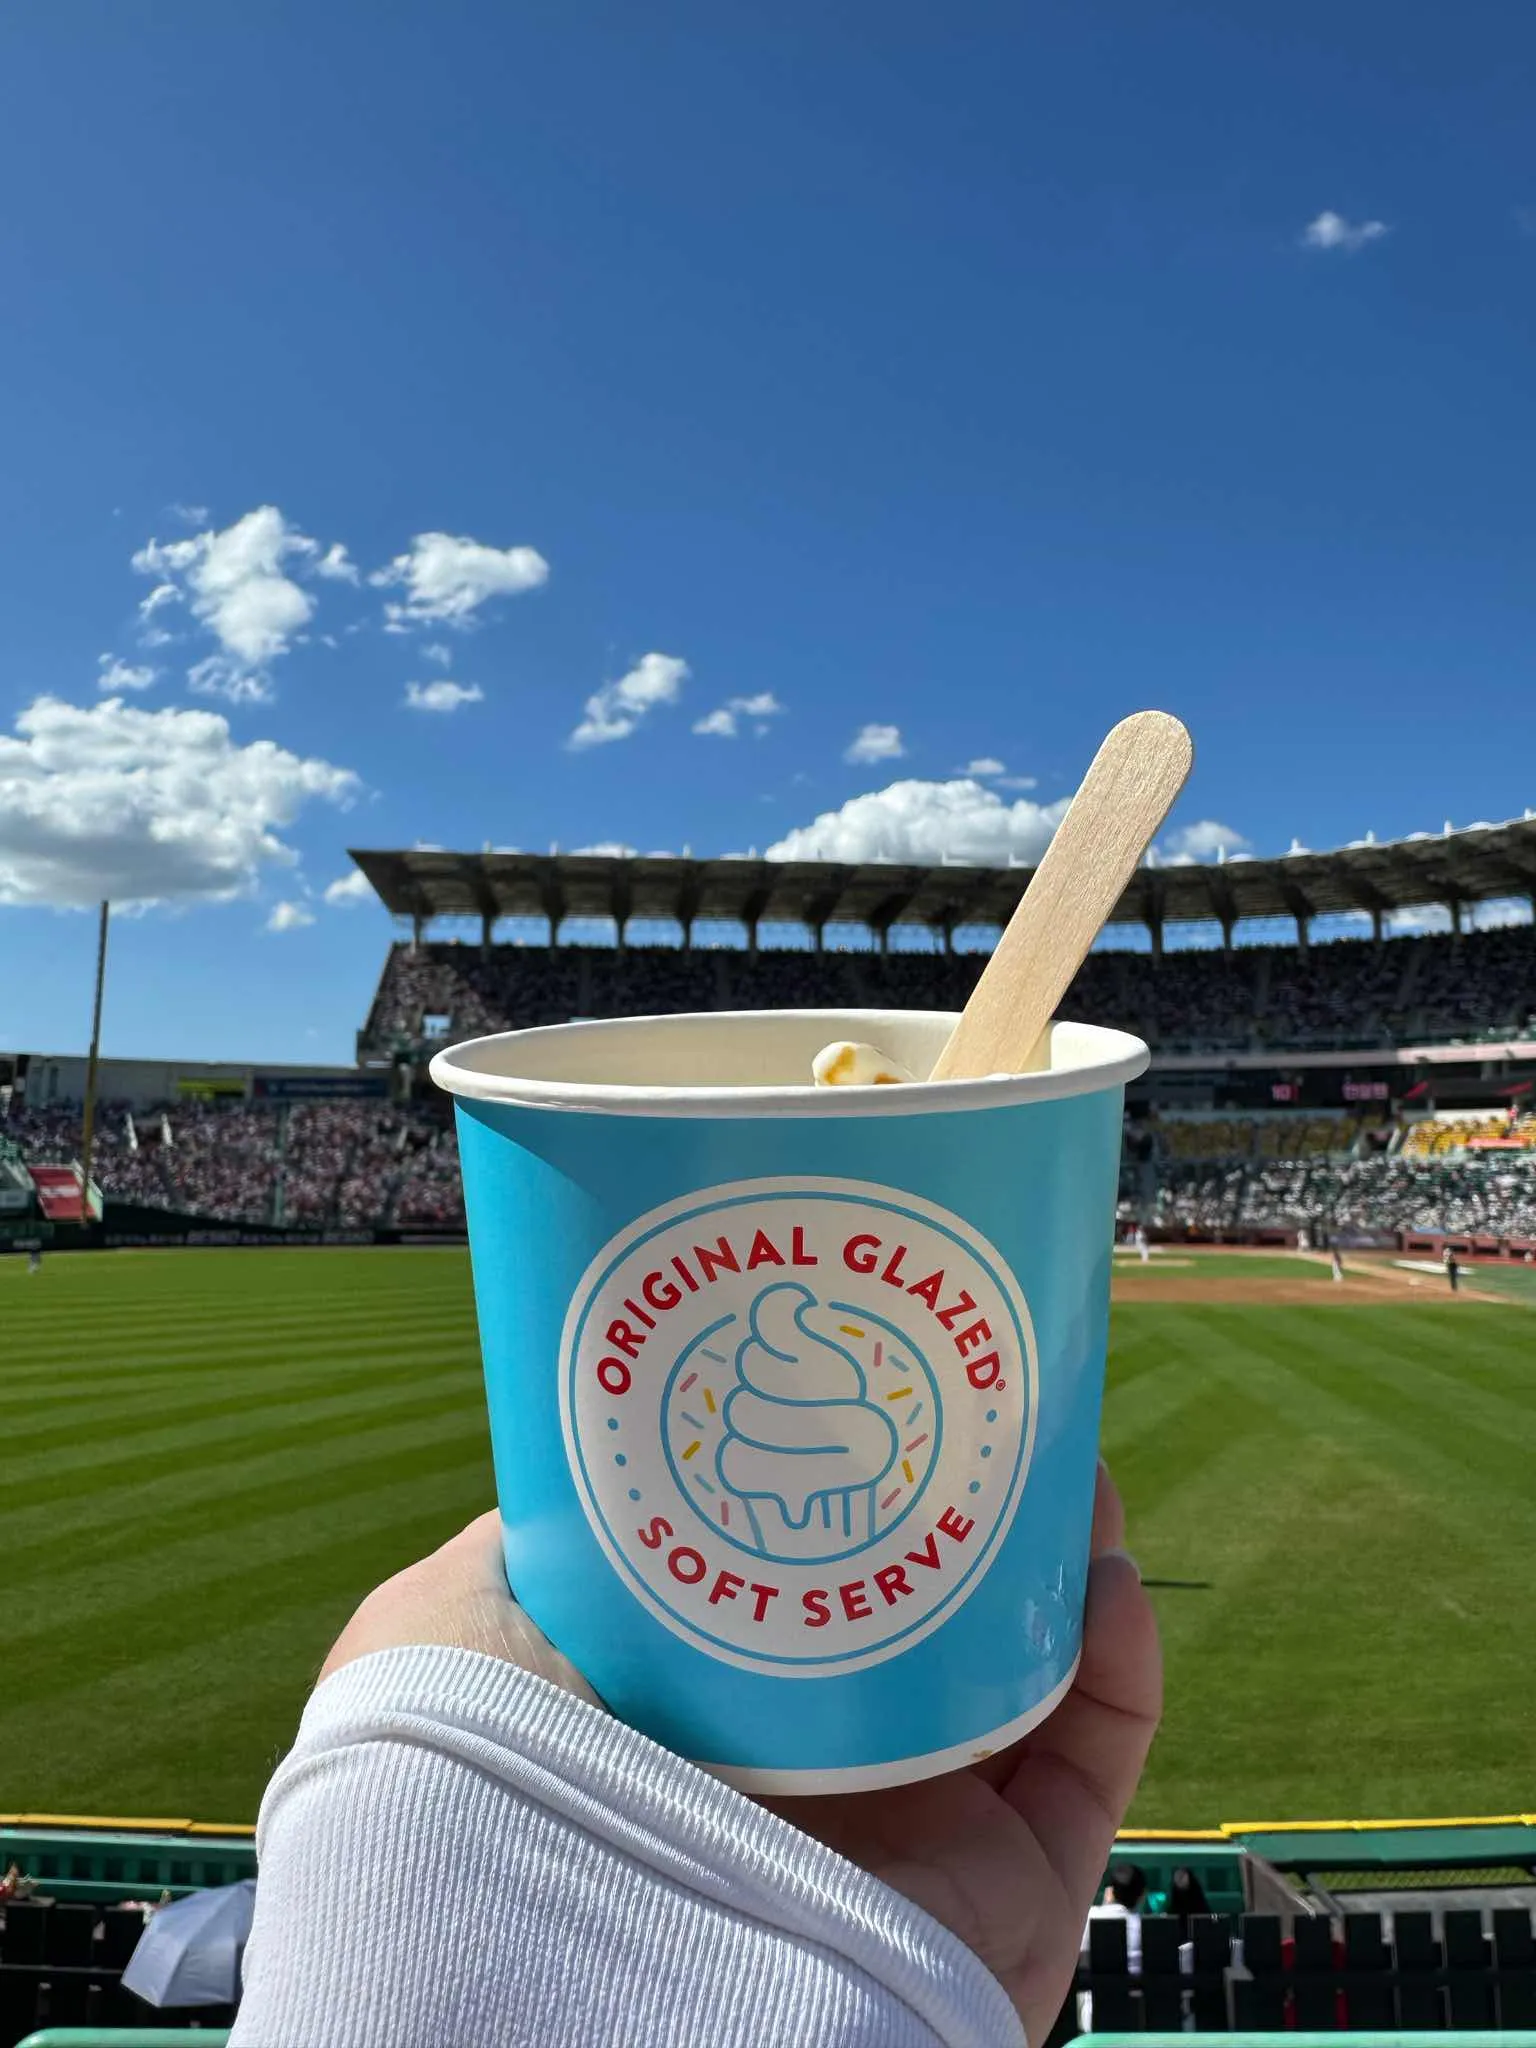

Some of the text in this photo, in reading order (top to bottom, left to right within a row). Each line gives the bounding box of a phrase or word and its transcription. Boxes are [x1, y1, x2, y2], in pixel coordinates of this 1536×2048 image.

[596, 1226, 818, 1396] ORIGINAL
[638, 1506, 975, 1628] SOFT SERVE
